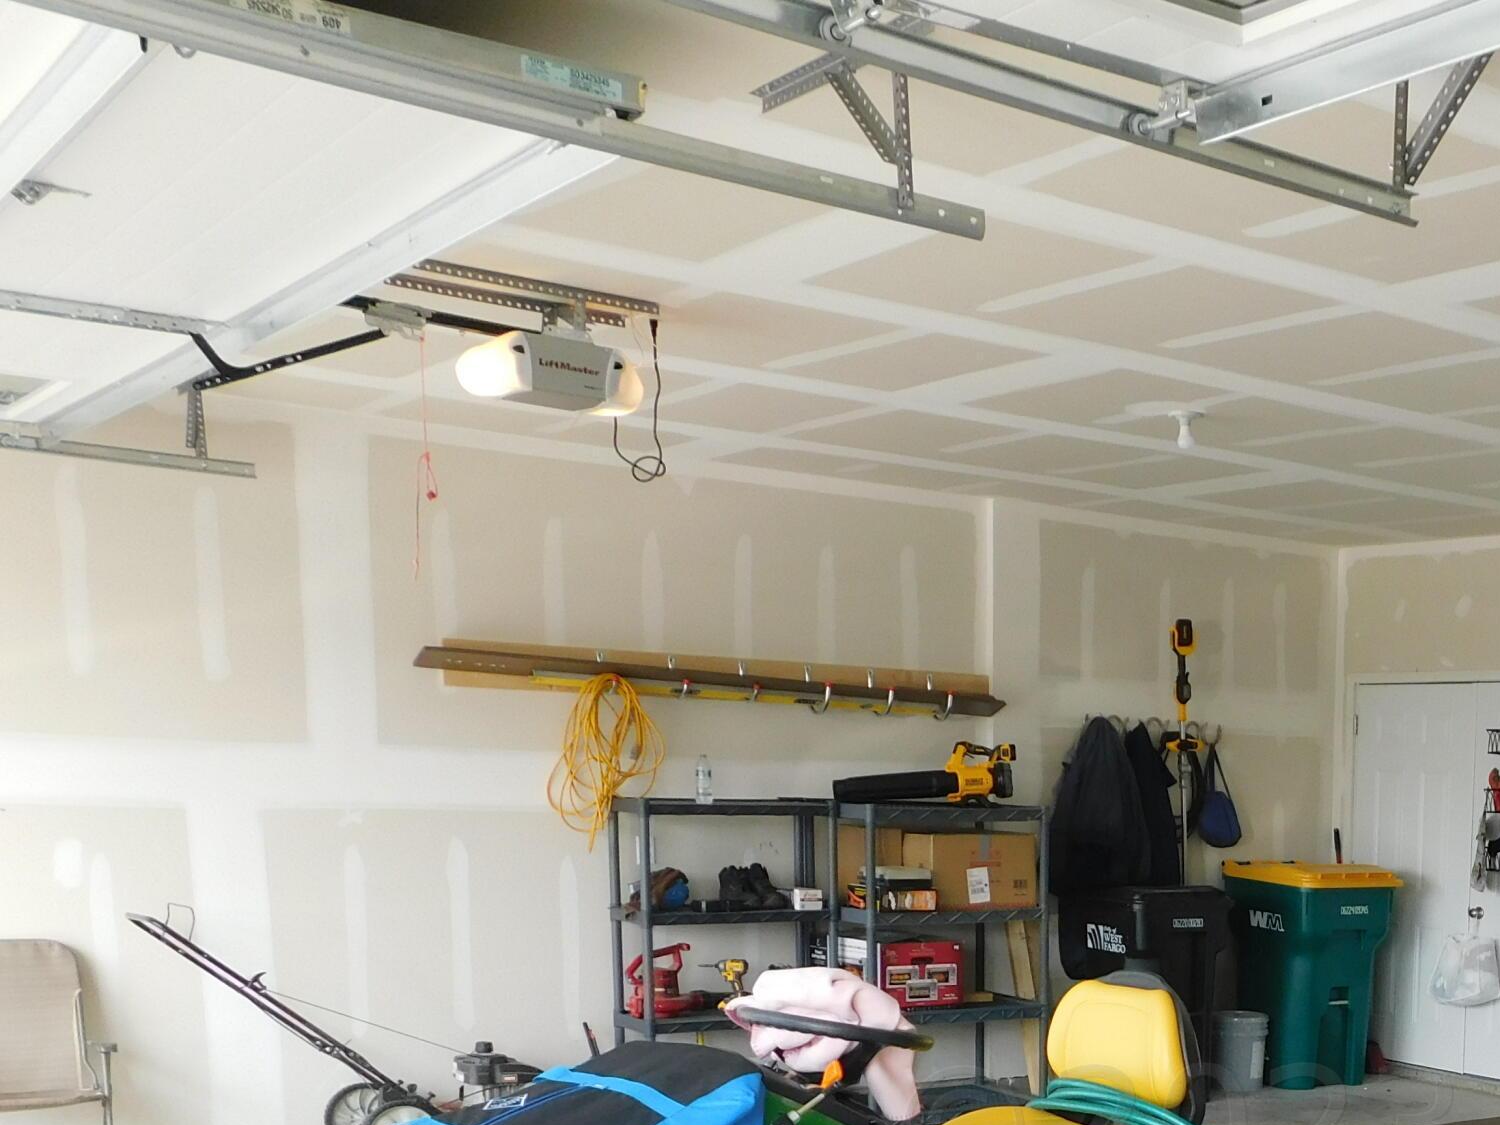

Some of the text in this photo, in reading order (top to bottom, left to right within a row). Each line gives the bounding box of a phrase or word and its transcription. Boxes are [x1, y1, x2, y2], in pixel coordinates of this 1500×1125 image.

[322, 15, 342, 29] 409
[539, 358, 599, 376] LiftMaster
[1248, 909, 1285, 932] WM
[1104, 933, 1123, 944] WEST
[1104, 942, 1126, 954] FARGO
